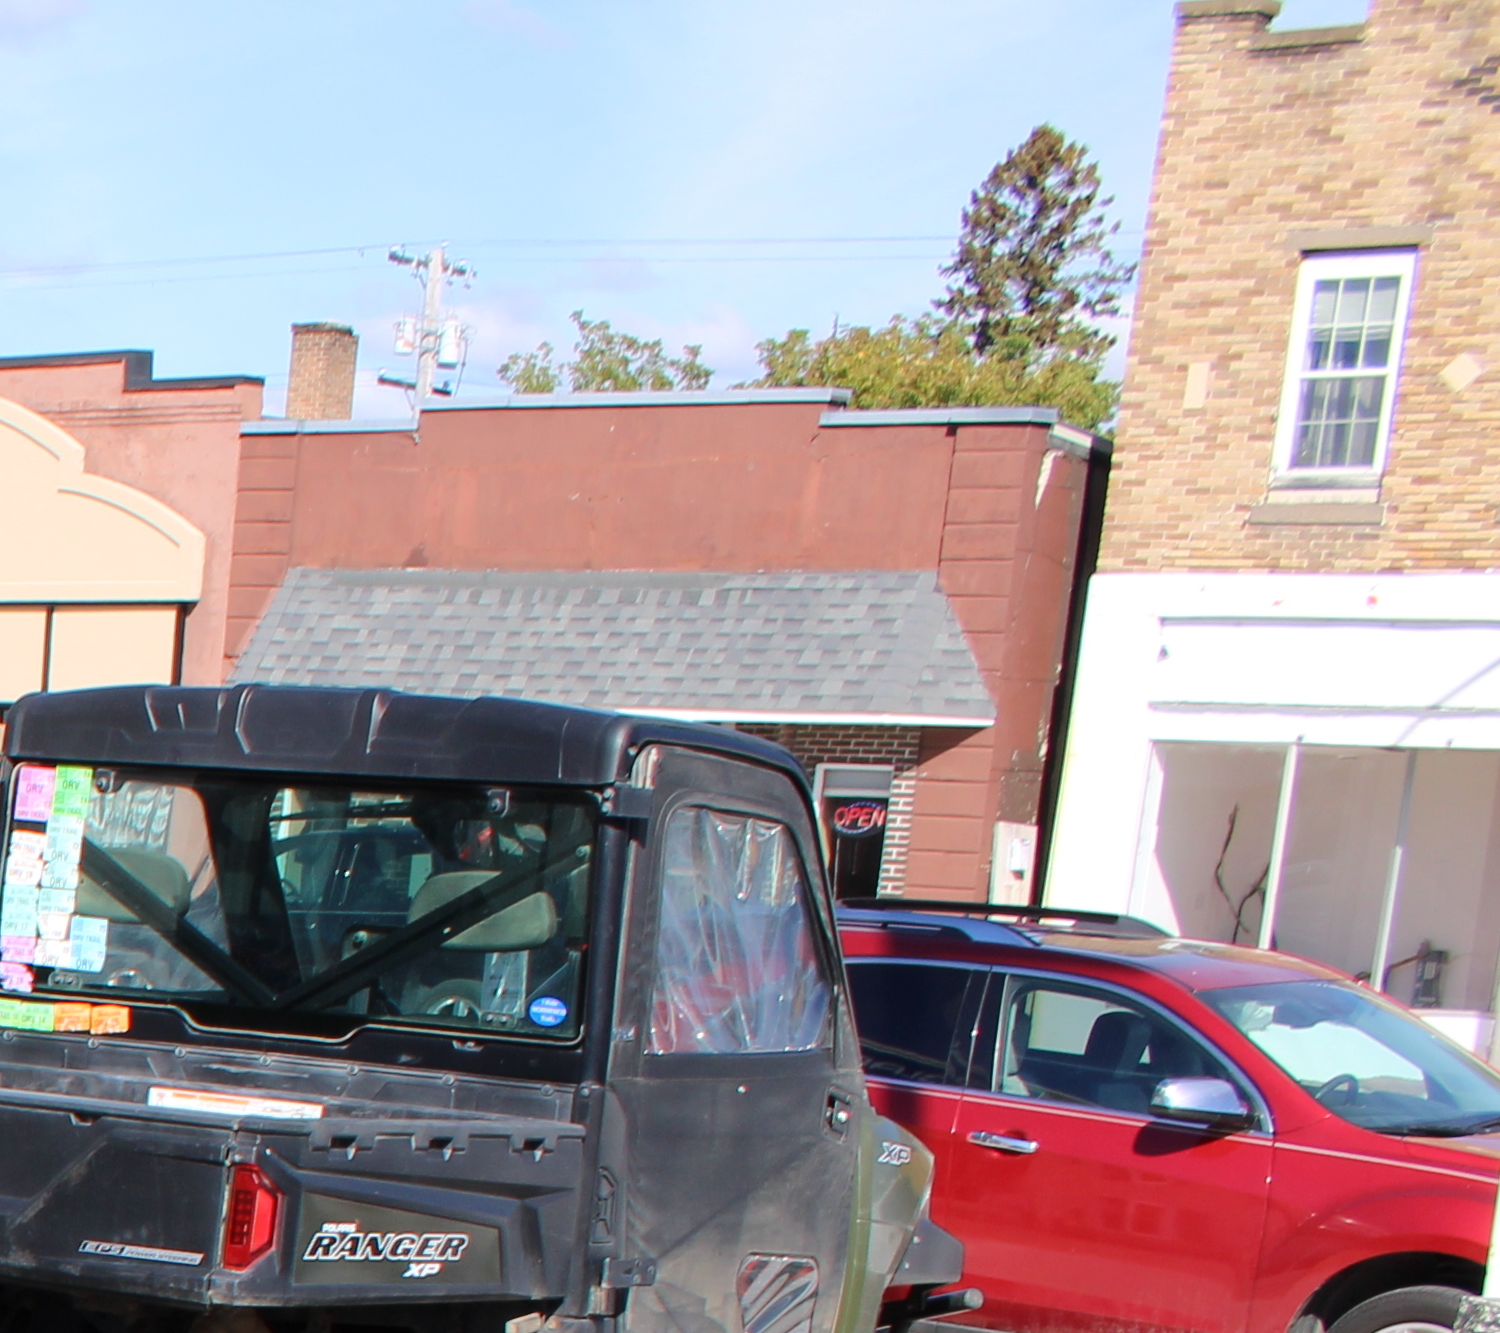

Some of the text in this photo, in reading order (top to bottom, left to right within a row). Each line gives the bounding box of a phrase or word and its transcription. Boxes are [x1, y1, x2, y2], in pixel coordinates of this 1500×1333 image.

[834, 805, 887, 827] OPEN
[877, 1141, 912, 1166] XP
[321, 1222, 358, 1233] POLARIS
[302, 1231, 471, 1262] RANGER
[402, 1263, 444, 1278] XP
